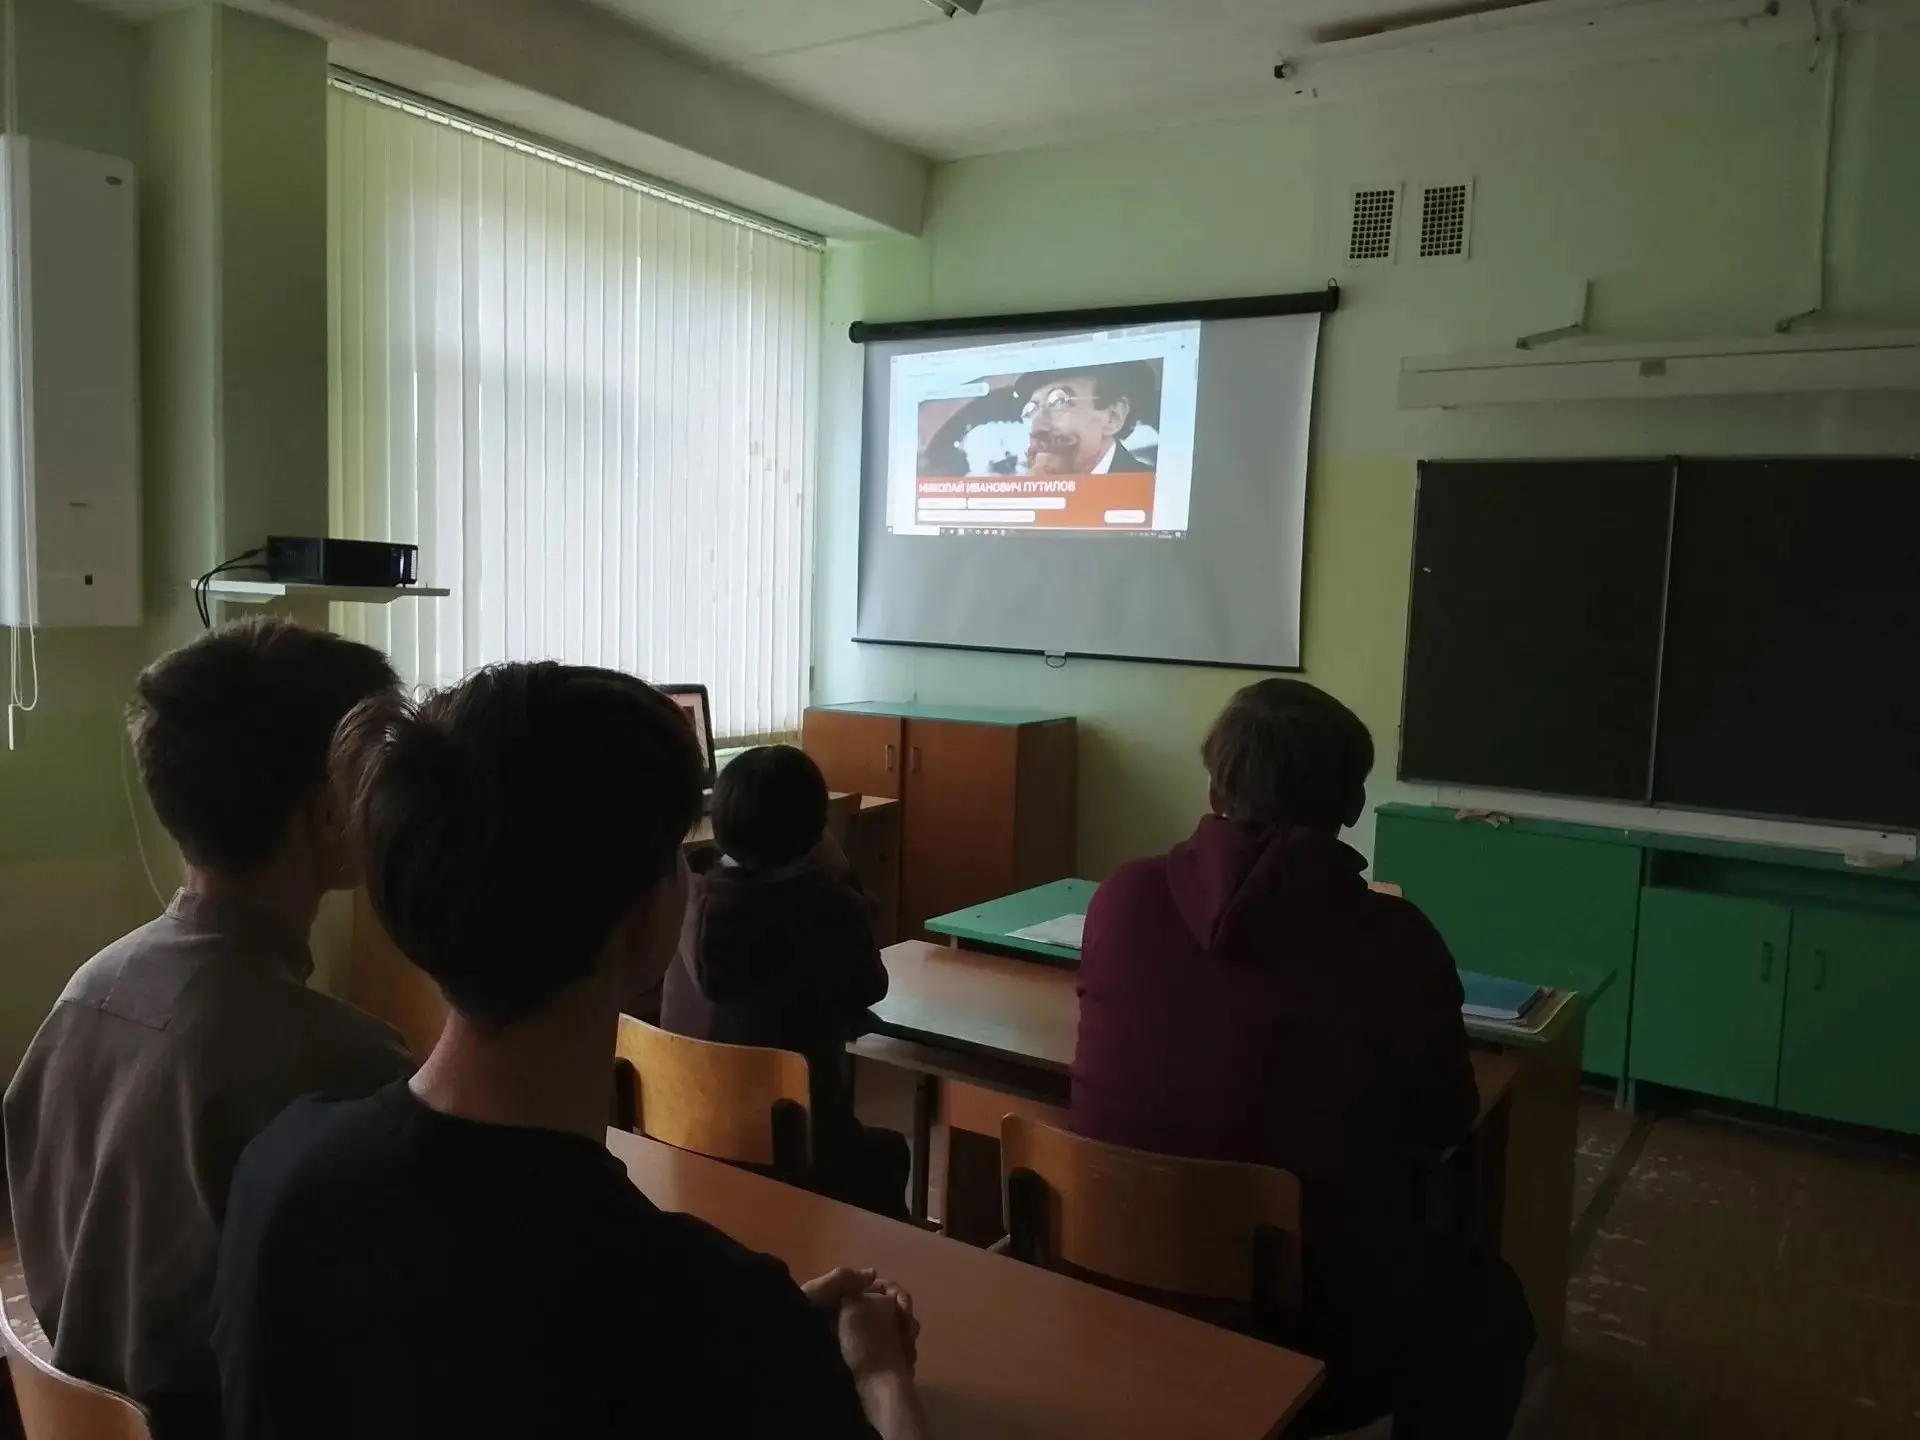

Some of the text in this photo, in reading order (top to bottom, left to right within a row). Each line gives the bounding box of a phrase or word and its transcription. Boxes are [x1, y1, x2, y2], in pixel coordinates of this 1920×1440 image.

[919, 479, 1076, 493] НОЛАЙ ИВАНОВИЧ ПУТИЛОВ
